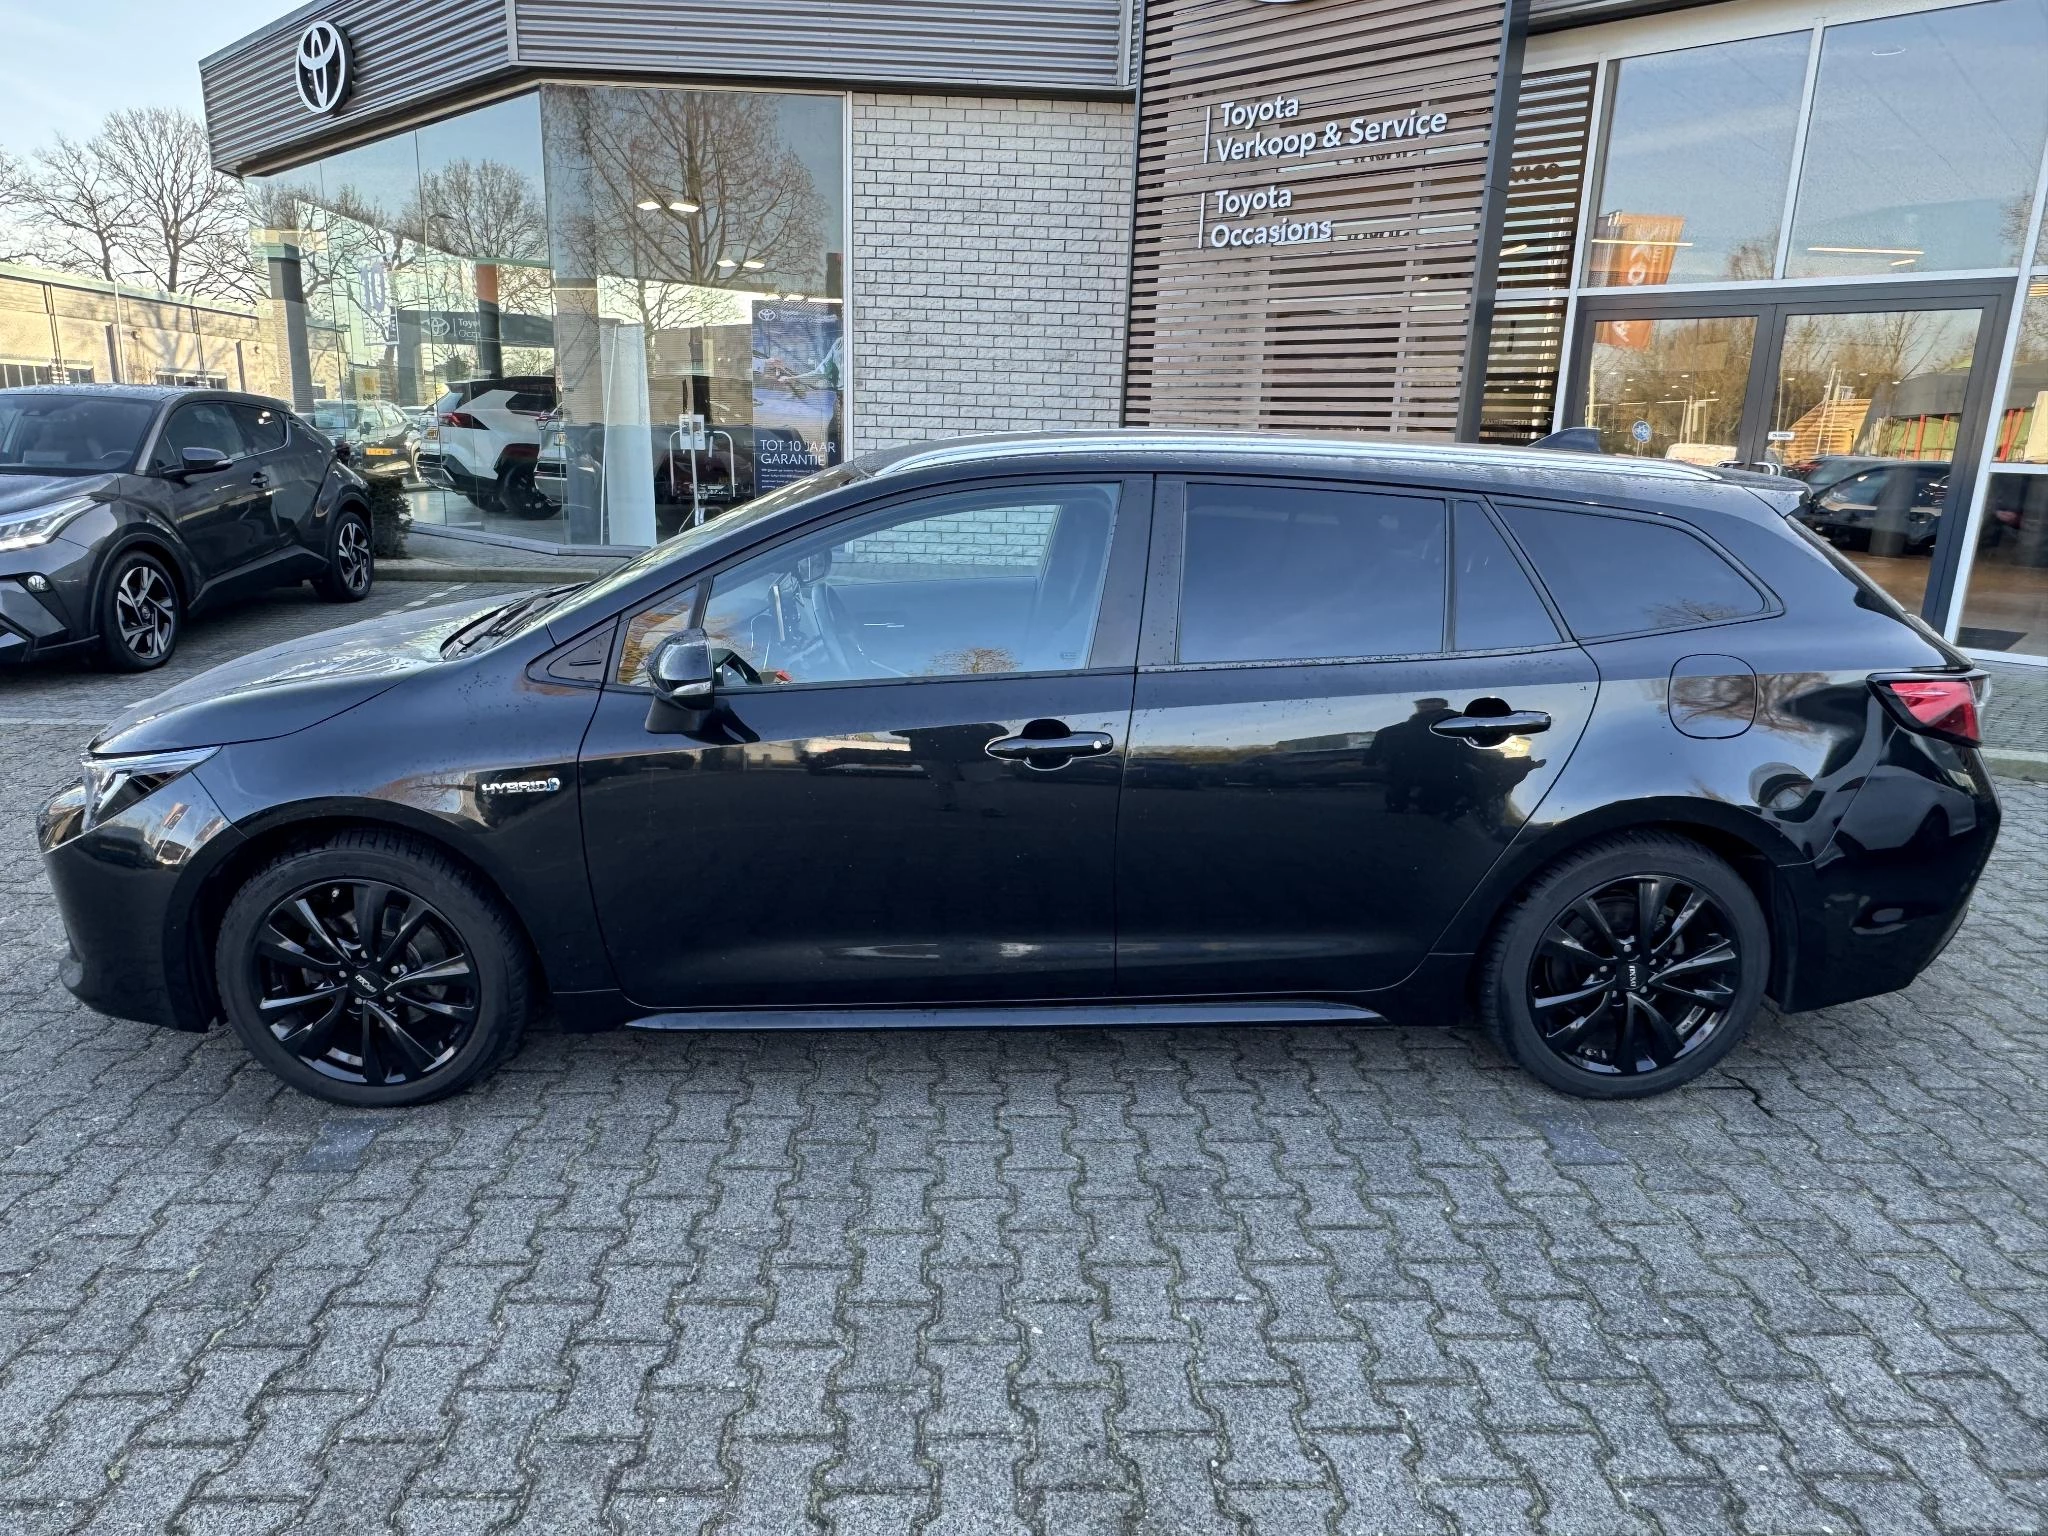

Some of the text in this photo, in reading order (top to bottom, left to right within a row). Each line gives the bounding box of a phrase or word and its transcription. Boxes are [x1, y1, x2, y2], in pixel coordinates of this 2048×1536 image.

[1221, 95, 1299, 129] Toyota
[1217, 109, 1448, 161] Verkoop & Service
[1215, 185, 1292, 217] Toyota
[1211, 217, 1331, 247] Occasions
[760, 439, 836, 453] TOT 10 JAAR
[760, 454, 826, 466] GARANTIE
[481, 780, 548, 795] HYBRID
